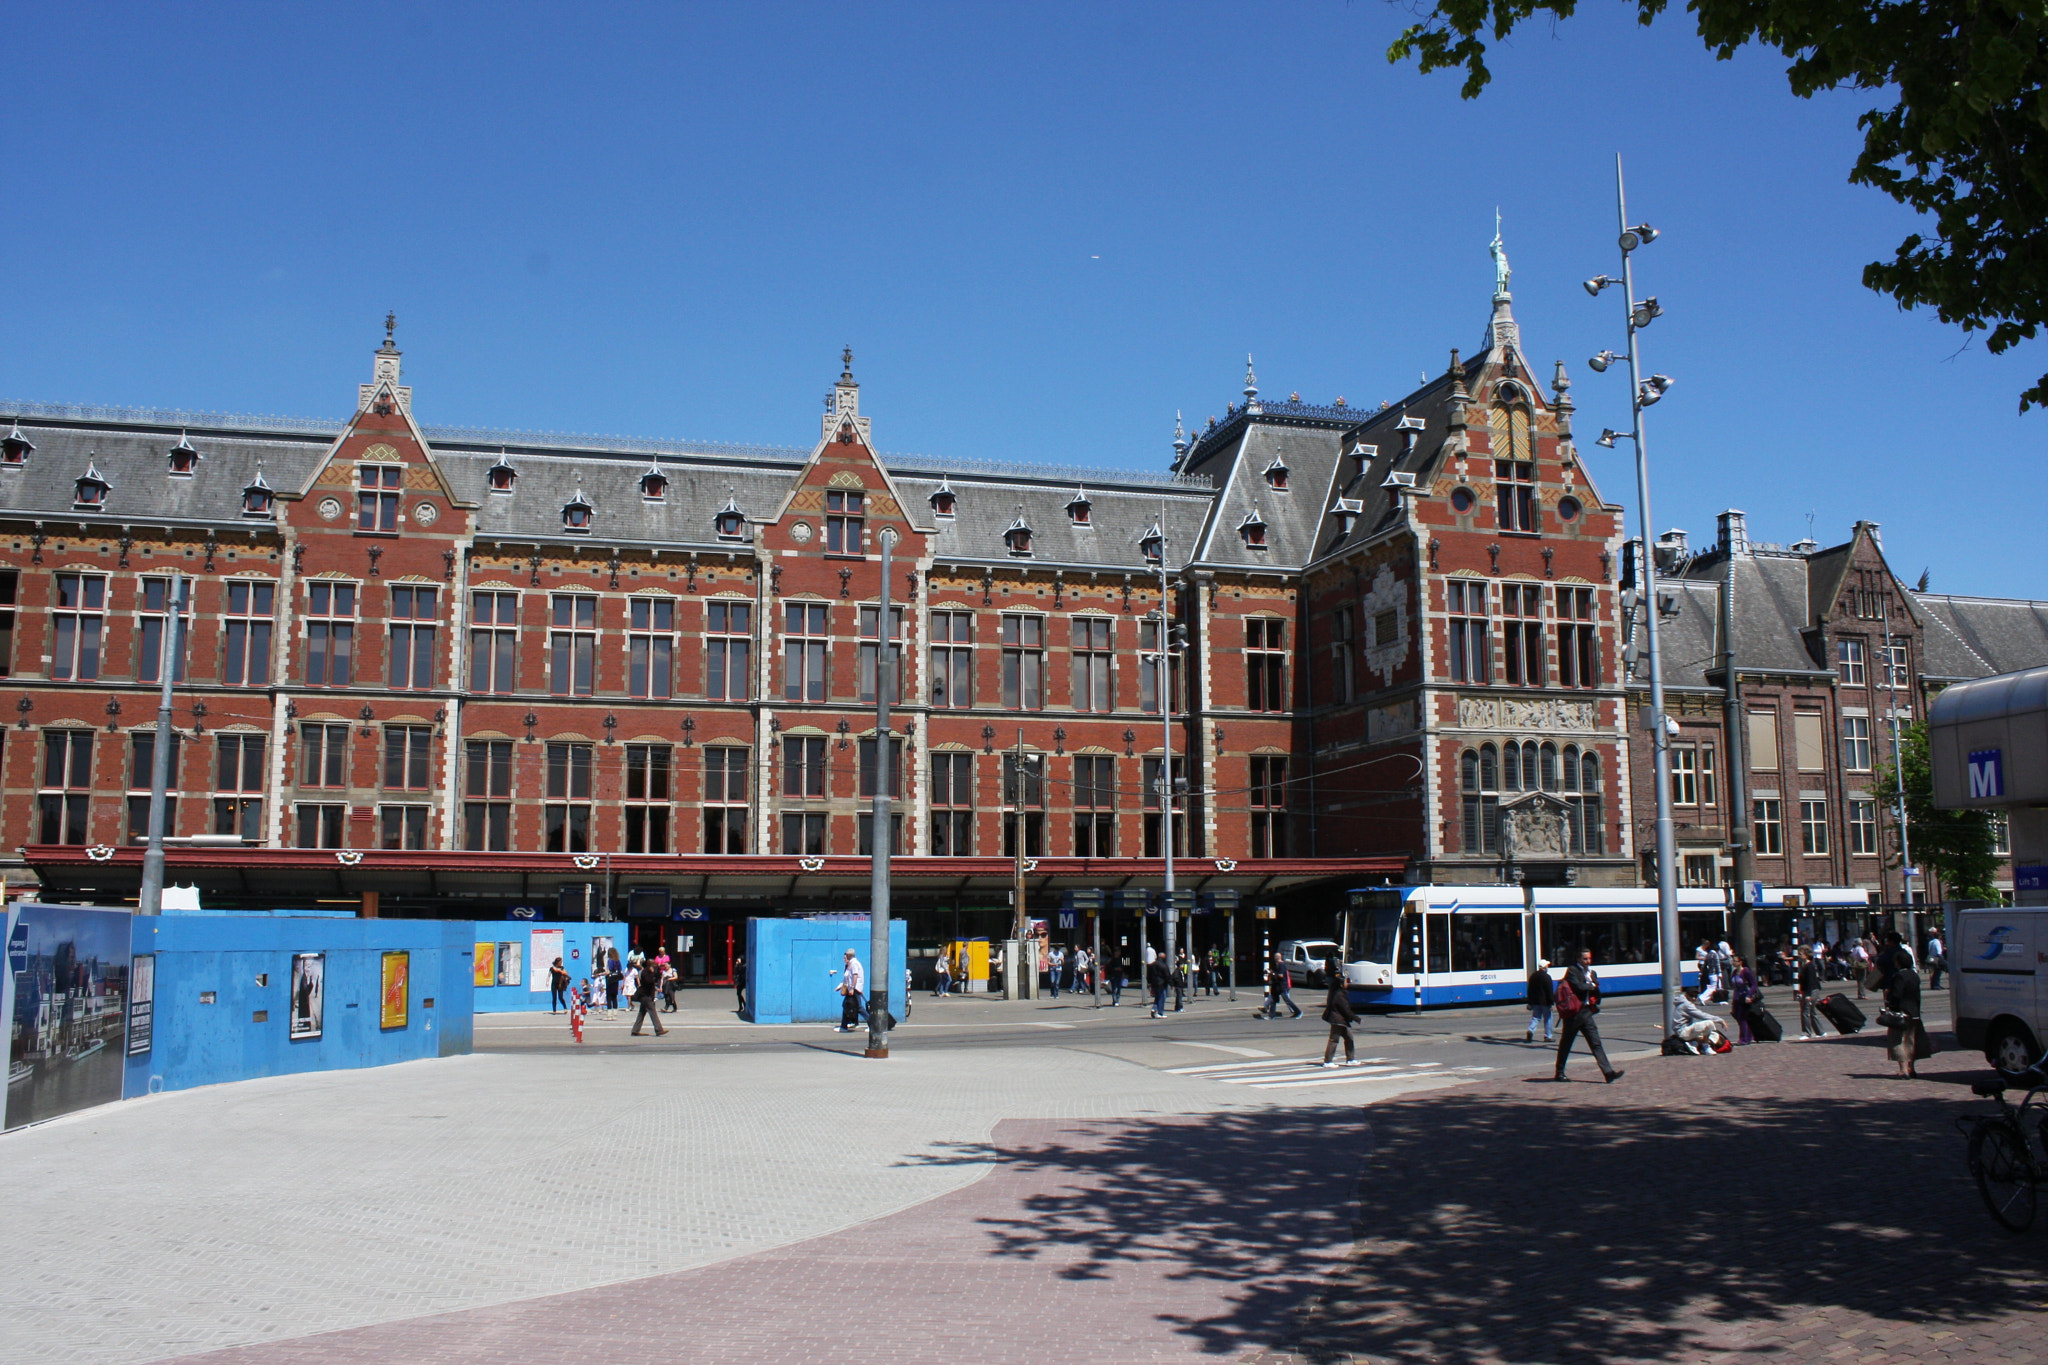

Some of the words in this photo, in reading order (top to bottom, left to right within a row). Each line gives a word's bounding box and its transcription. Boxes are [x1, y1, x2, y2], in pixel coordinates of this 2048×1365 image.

[1968, 760, 1997, 798] M
[2018, 877, 2030, 886] Lift
[1059, 913, 1074, 928] M
